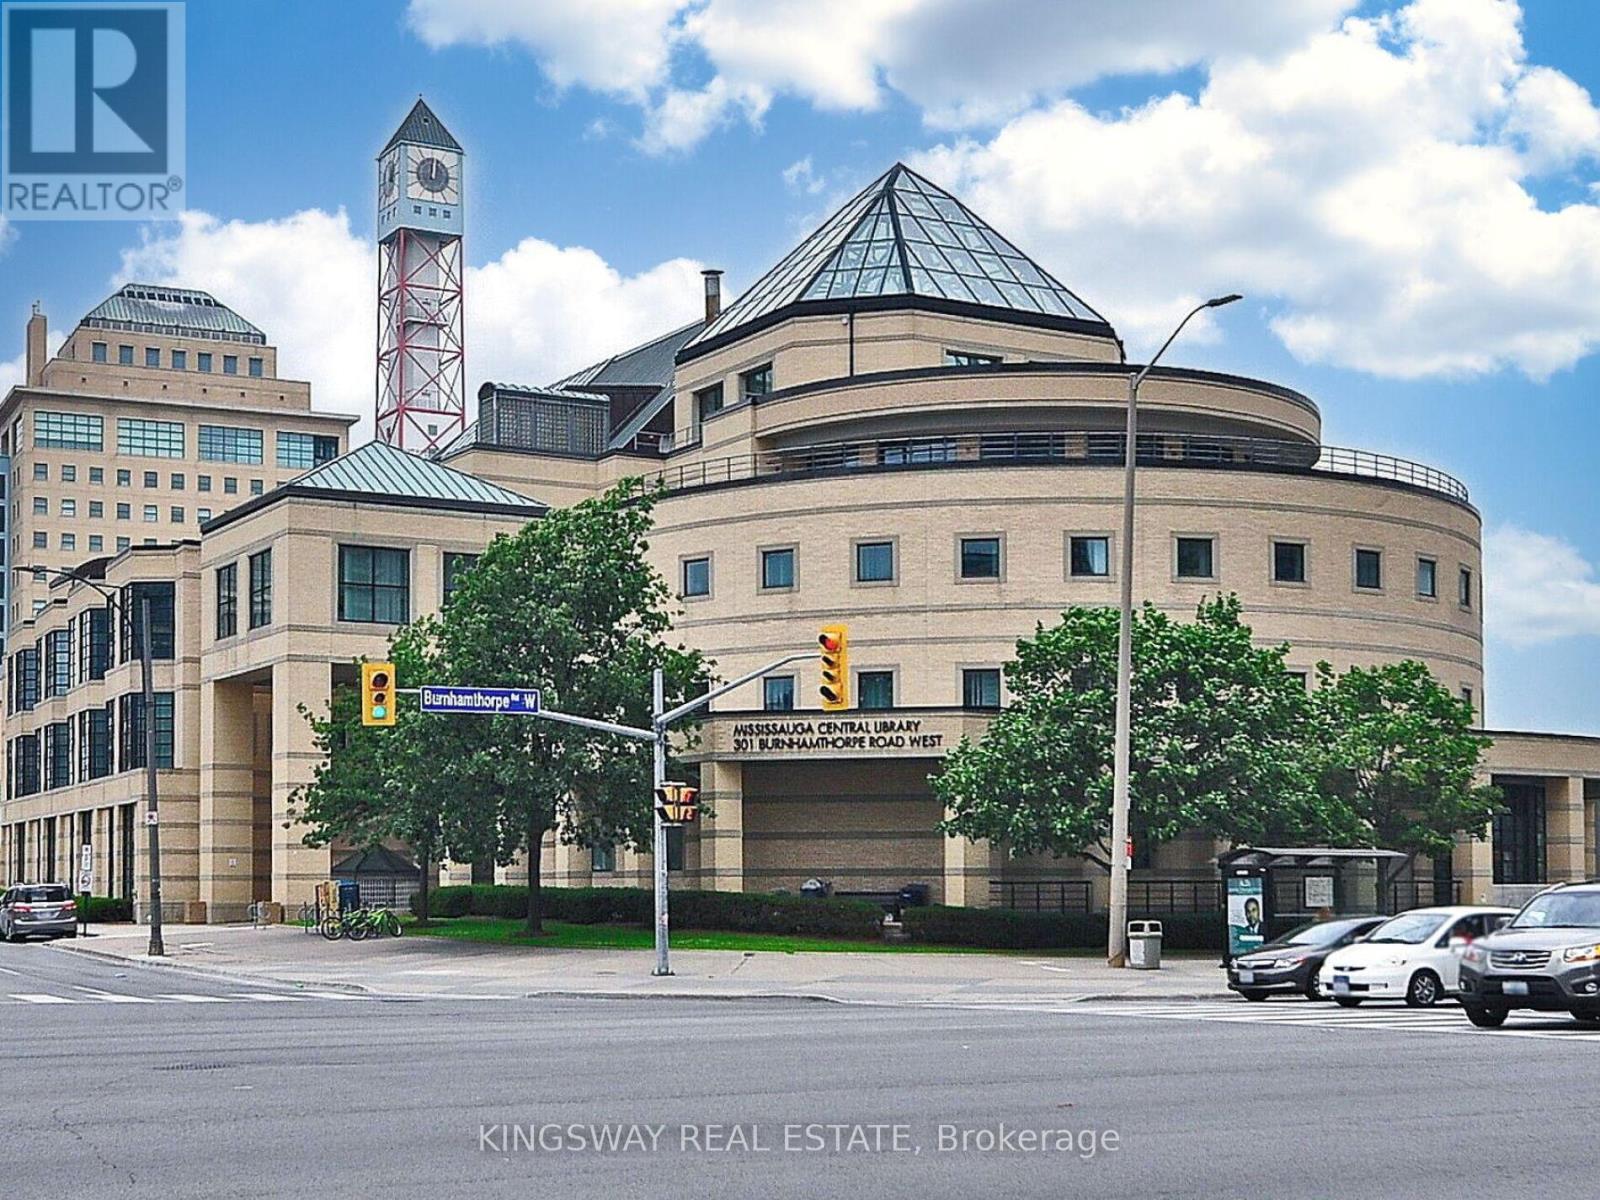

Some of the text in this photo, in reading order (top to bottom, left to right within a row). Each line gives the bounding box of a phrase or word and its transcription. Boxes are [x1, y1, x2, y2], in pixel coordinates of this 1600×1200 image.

[424, 690, 510, 711] Burnhamthorpe
[524, 693, 536, 709] W
[733, 719, 921, 737] MISSISSAUGA CENTRAL LIBRARY
[733, 734, 943, 751] 301 BURNHAMTHORPE ROAD WEST
